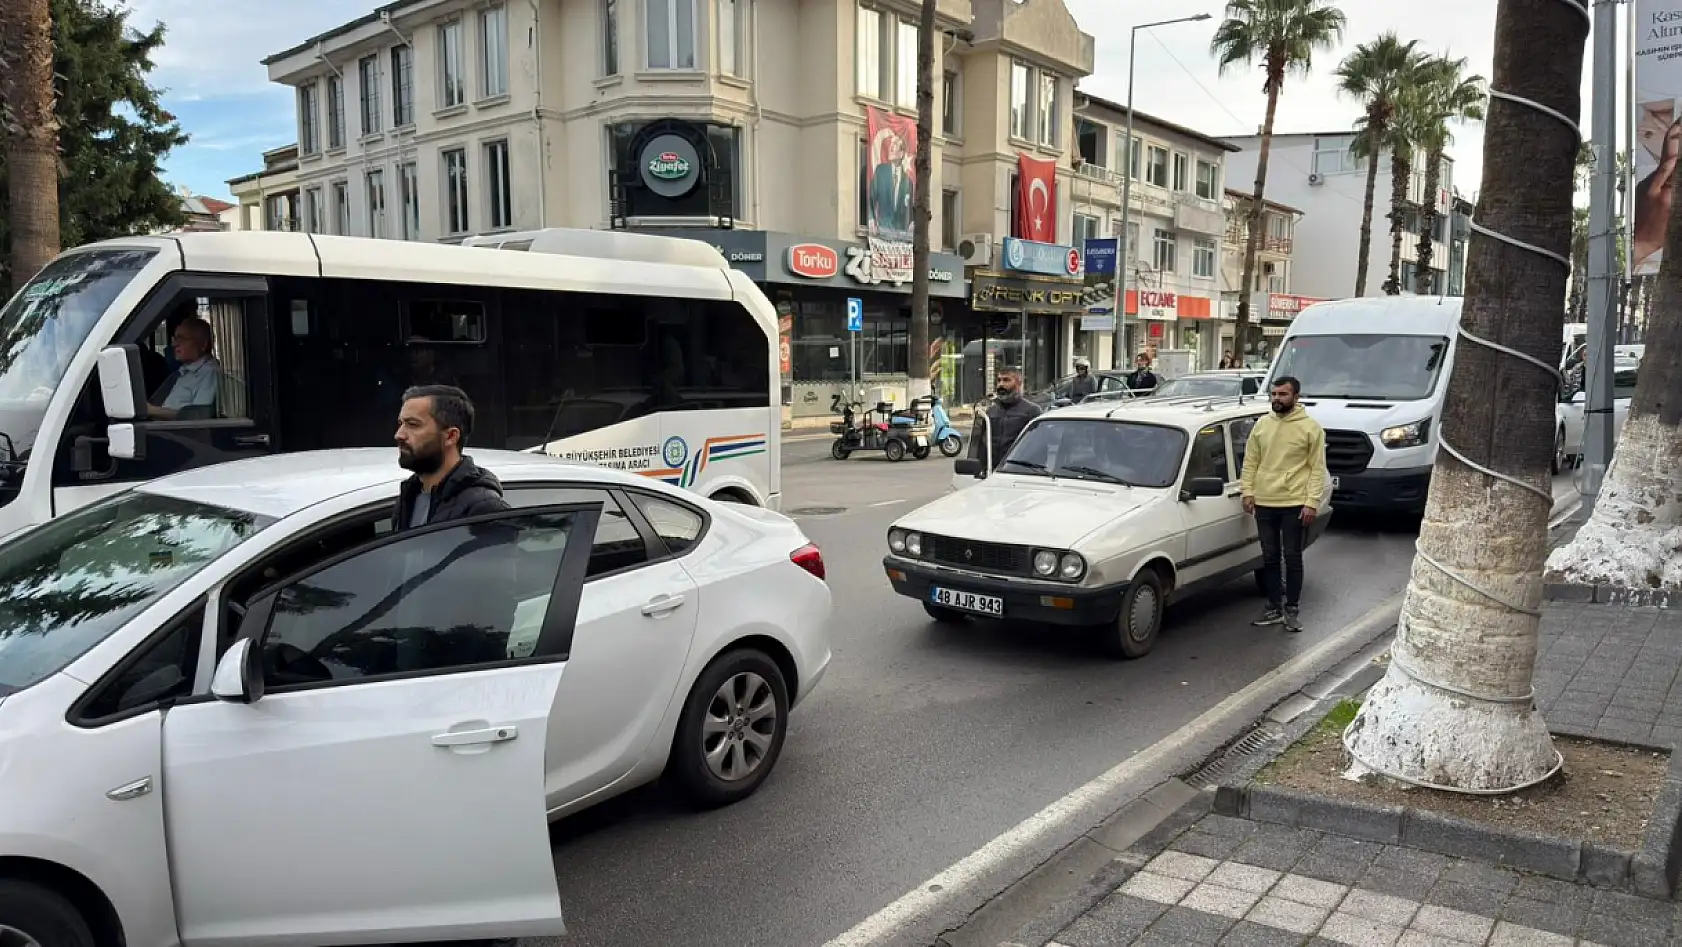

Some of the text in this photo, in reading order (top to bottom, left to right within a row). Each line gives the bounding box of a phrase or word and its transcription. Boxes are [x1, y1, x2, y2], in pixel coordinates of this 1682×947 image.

[731, 251, 762, 260] DÖNER
[797, 249, 832, 269] Torku
[995, 286, 1045, 303] RENK
[1140, 290, 1176, 308] ECZANE
[849, 301, 859, 328] P
[618, 443, 660, 457] BELEDİYESİ
[628, 459, 650, 469] ARACI
[938, 589, 1001, 614] 48 AJR 943
